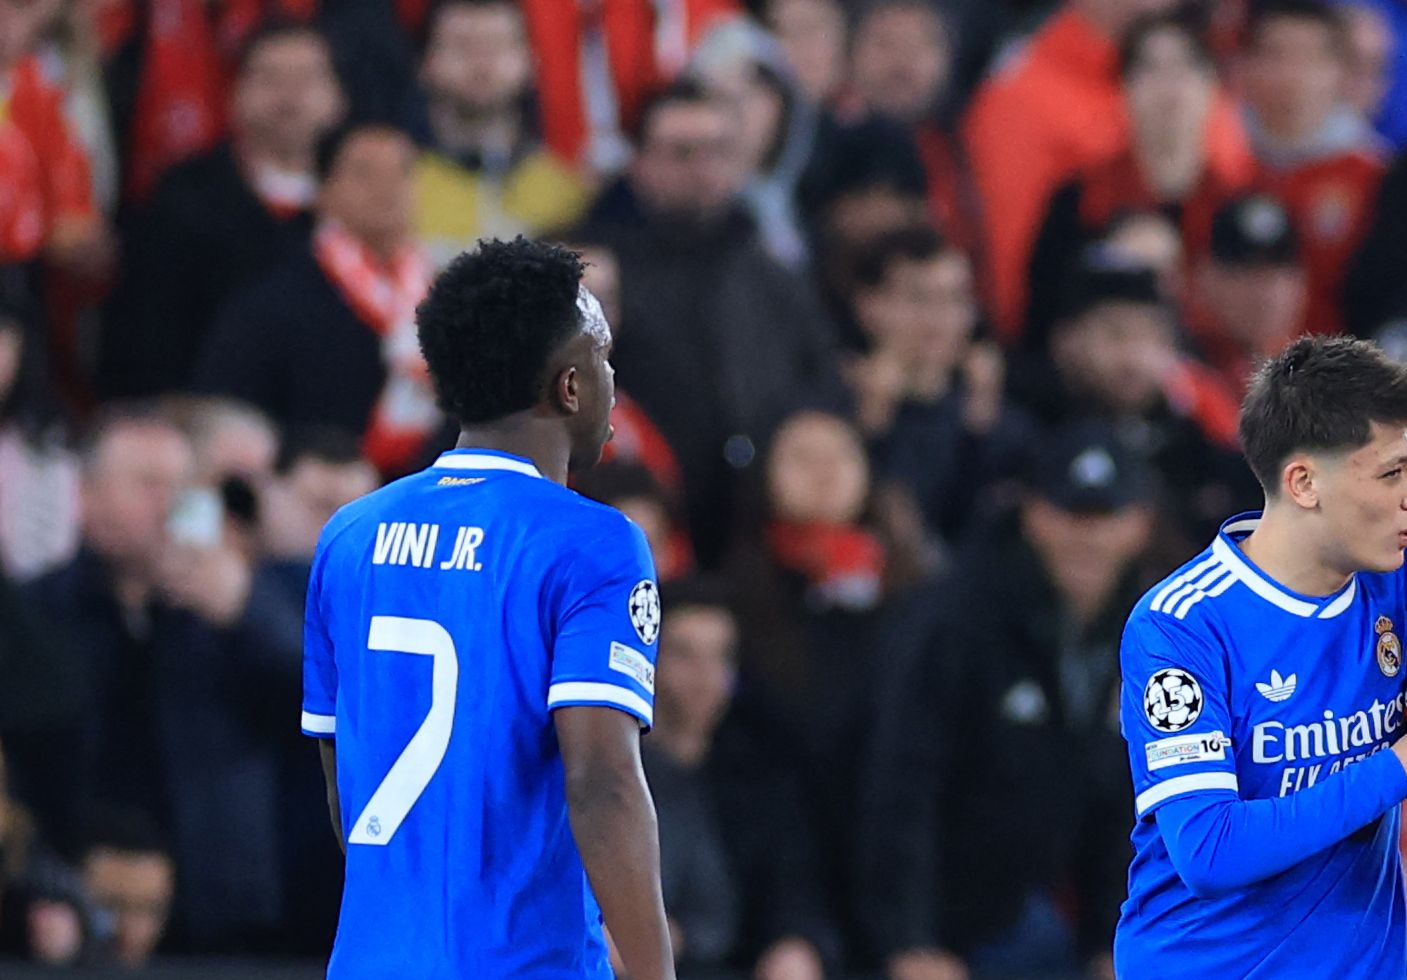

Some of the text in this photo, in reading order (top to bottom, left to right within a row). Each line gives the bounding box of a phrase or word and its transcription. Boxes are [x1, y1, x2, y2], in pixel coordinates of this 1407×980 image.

[372, 522, 486, 571] VINI JR.
[1155, 686, 1186, 715] 15
[348, 615, 459, 846] 7
